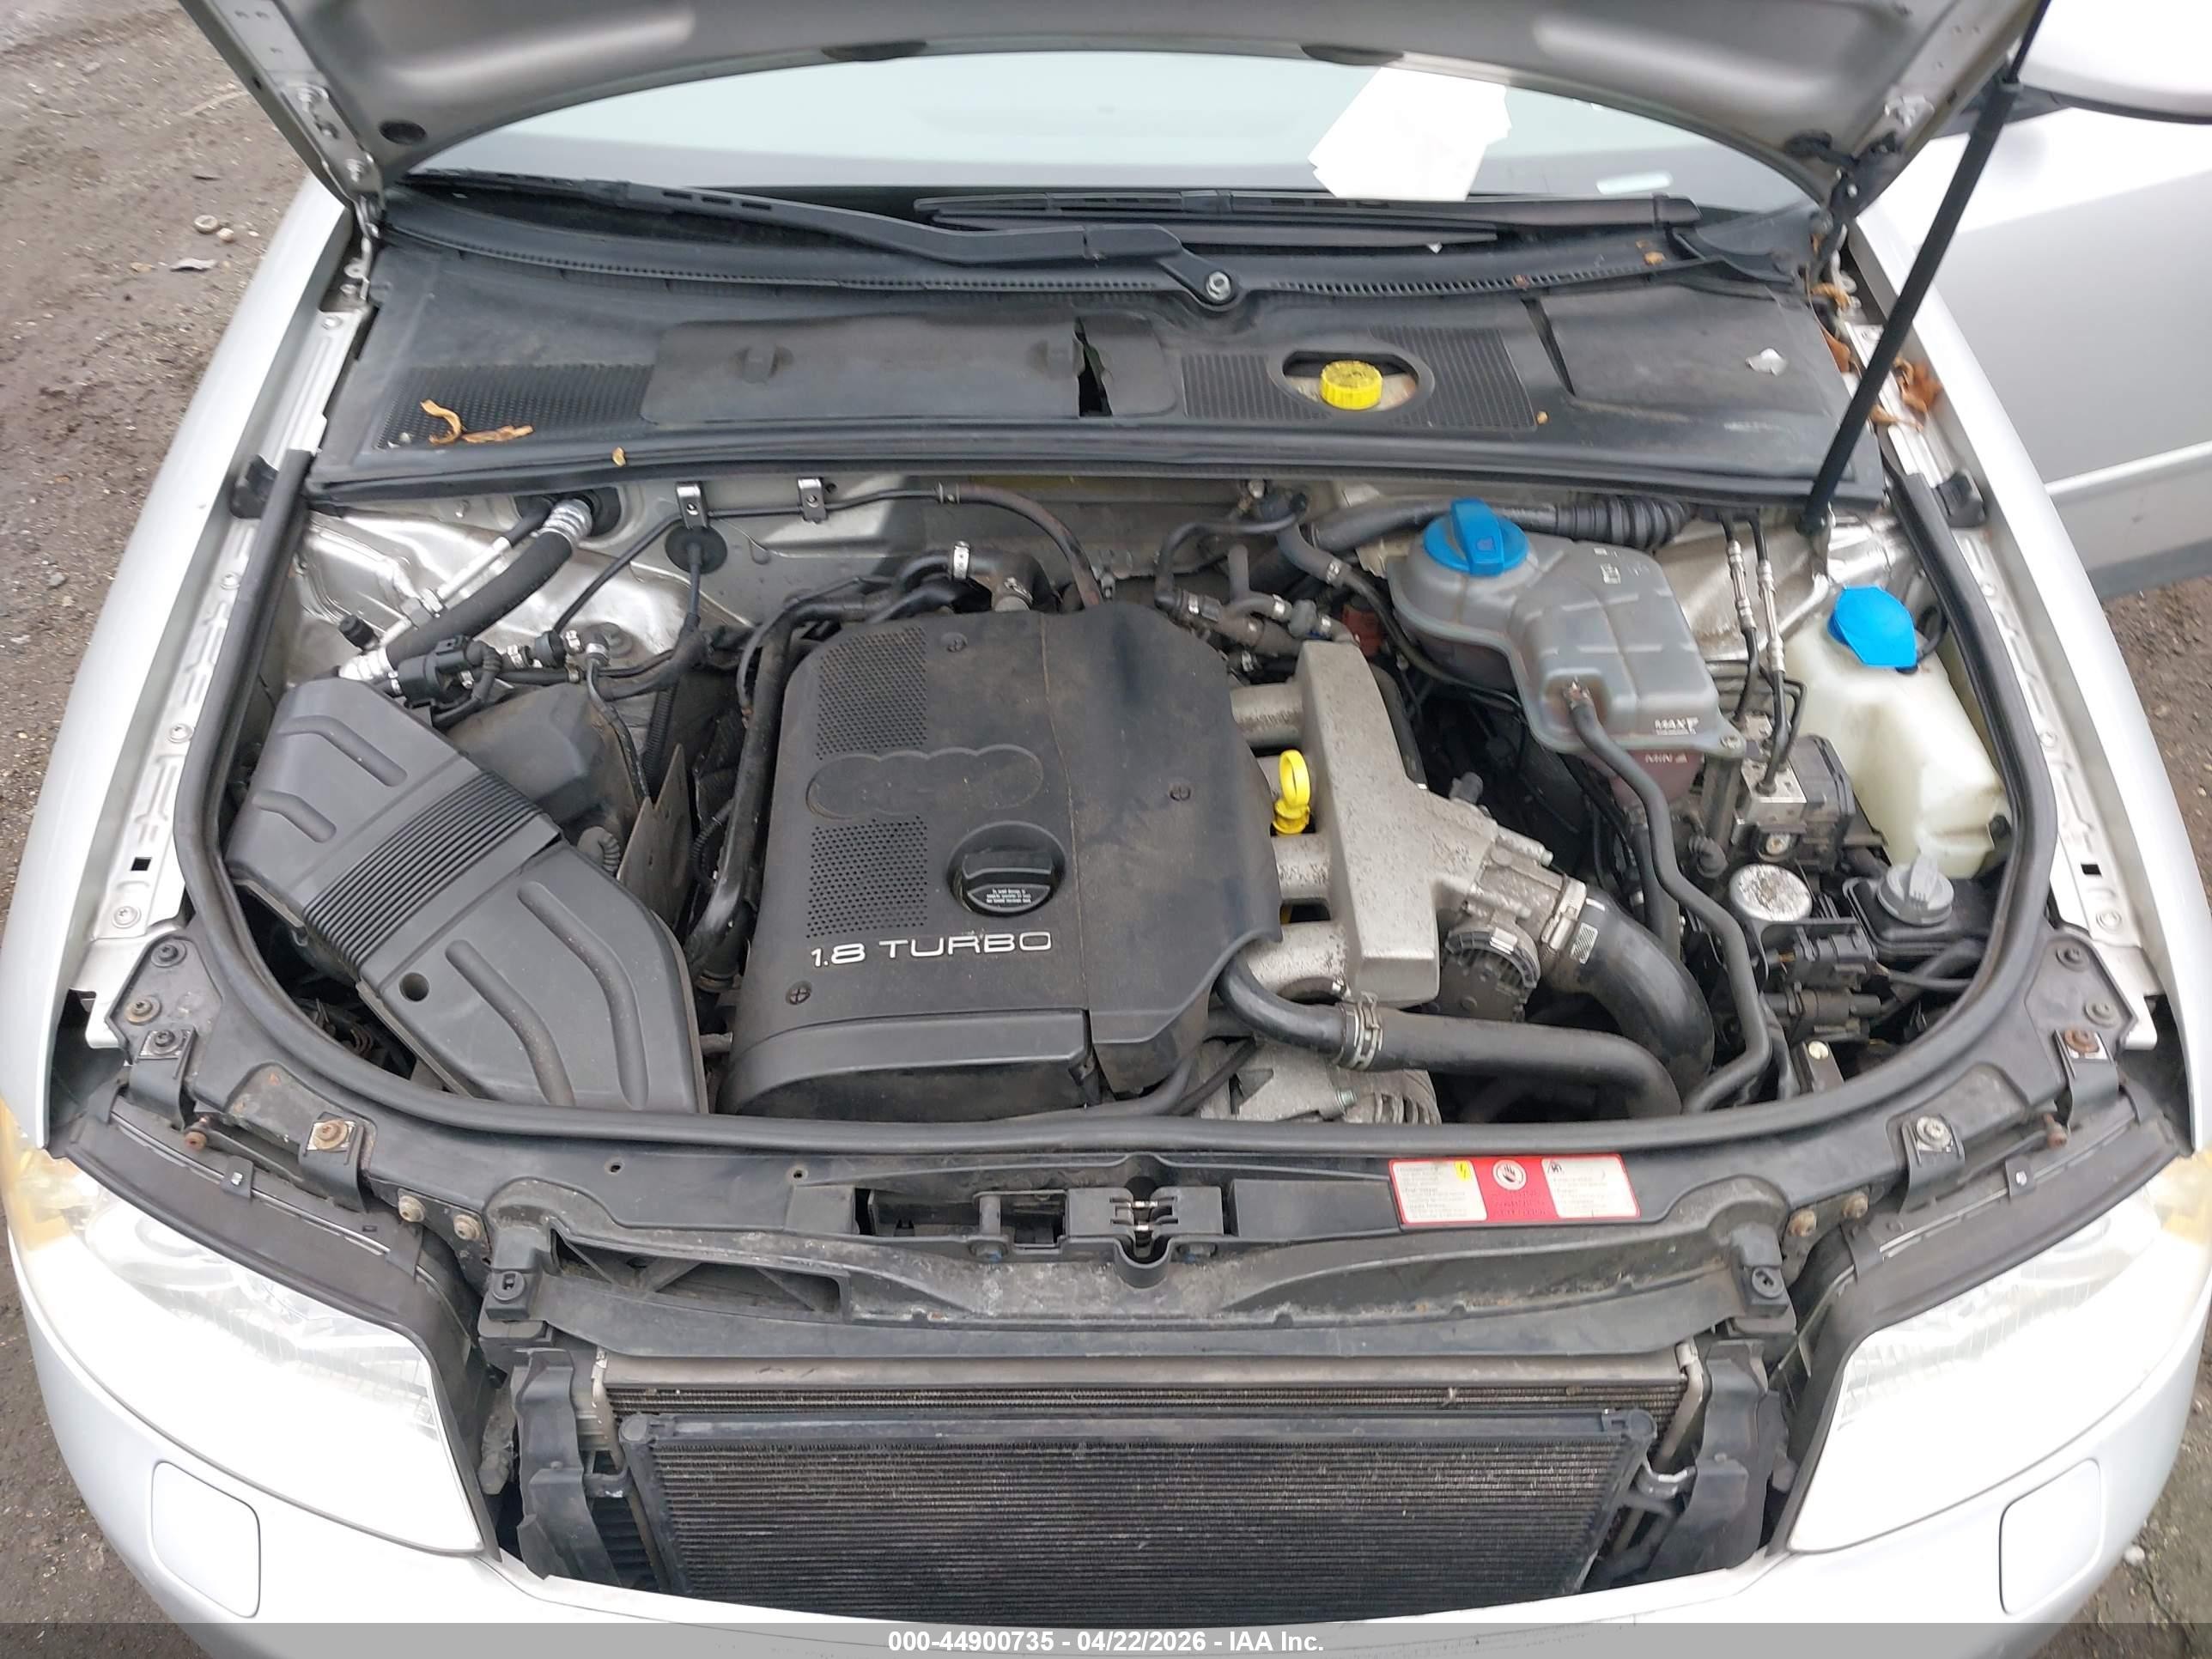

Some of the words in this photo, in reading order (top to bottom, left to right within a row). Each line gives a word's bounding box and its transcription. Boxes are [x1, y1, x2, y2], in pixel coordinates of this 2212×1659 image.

[1654, 718, 1688, 730] MAX
[1644, 752, 1674, 763] MIN
[811, 943, 866, 967] 1.8
[878, 931, 1052, 958] TURBO
